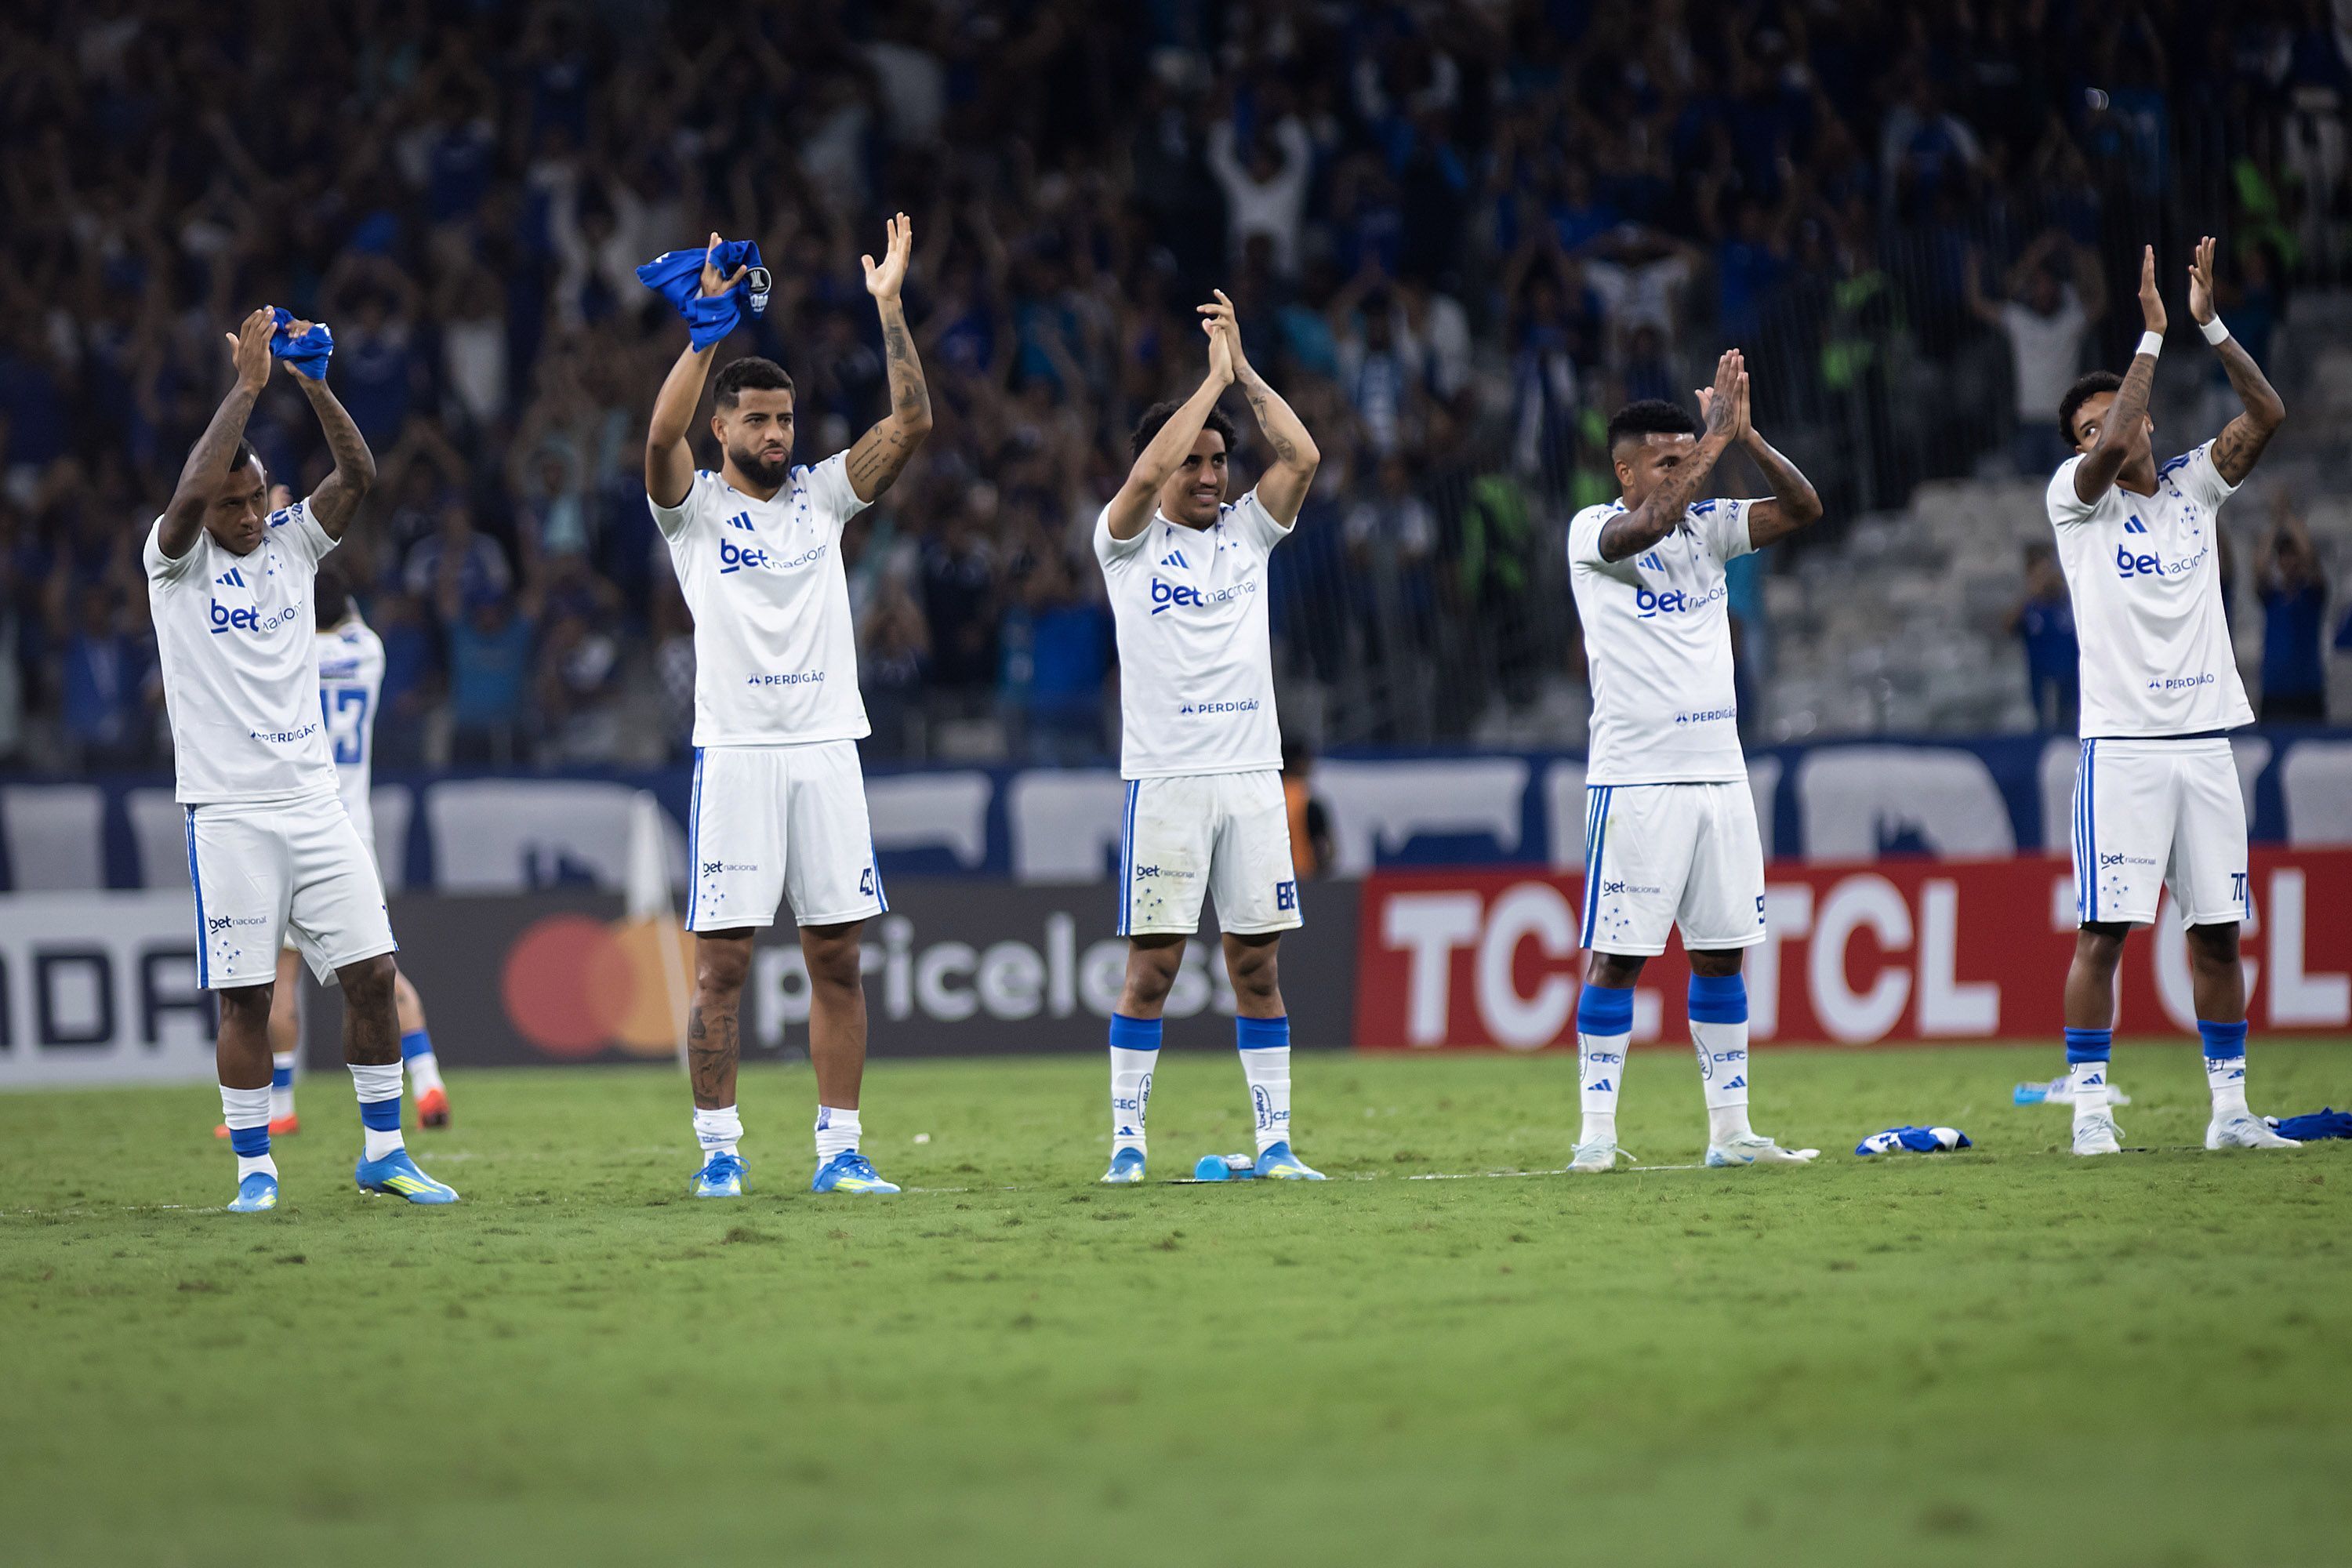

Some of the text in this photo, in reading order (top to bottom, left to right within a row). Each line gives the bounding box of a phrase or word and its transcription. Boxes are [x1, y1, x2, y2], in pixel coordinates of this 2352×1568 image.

[720, 538, 770, 573] bet
[2117, 544, 2164, 578] bet
[1152, 578, 1203, 615] bet
[1635, 584, 1686, 618] bet
[210, 597, 260, 633] bet
[765, 670, 826, 686] PERDIGÃO
[2165, 673, 2214, 689] PERDIÃO
[1199, 699, 1259, 713] PERDIGÃO
[702, 860, 723, 878] bet
[2101, 853, 2124, 870] bet
[1136, 864, 1196, 881] bet nacional
[1602, 880, 1625, 896] bet
[208, 916, 267, 935] bet nacional
[0, 943, 220, 1051] DA
[1590, 1053, 1621, 1065] CEC
[1713, 1050, 1746, 1062] CEC
[1113, 1098, 1137, 1110] CEC
[1273, 1110, 1290, 1121] CE
